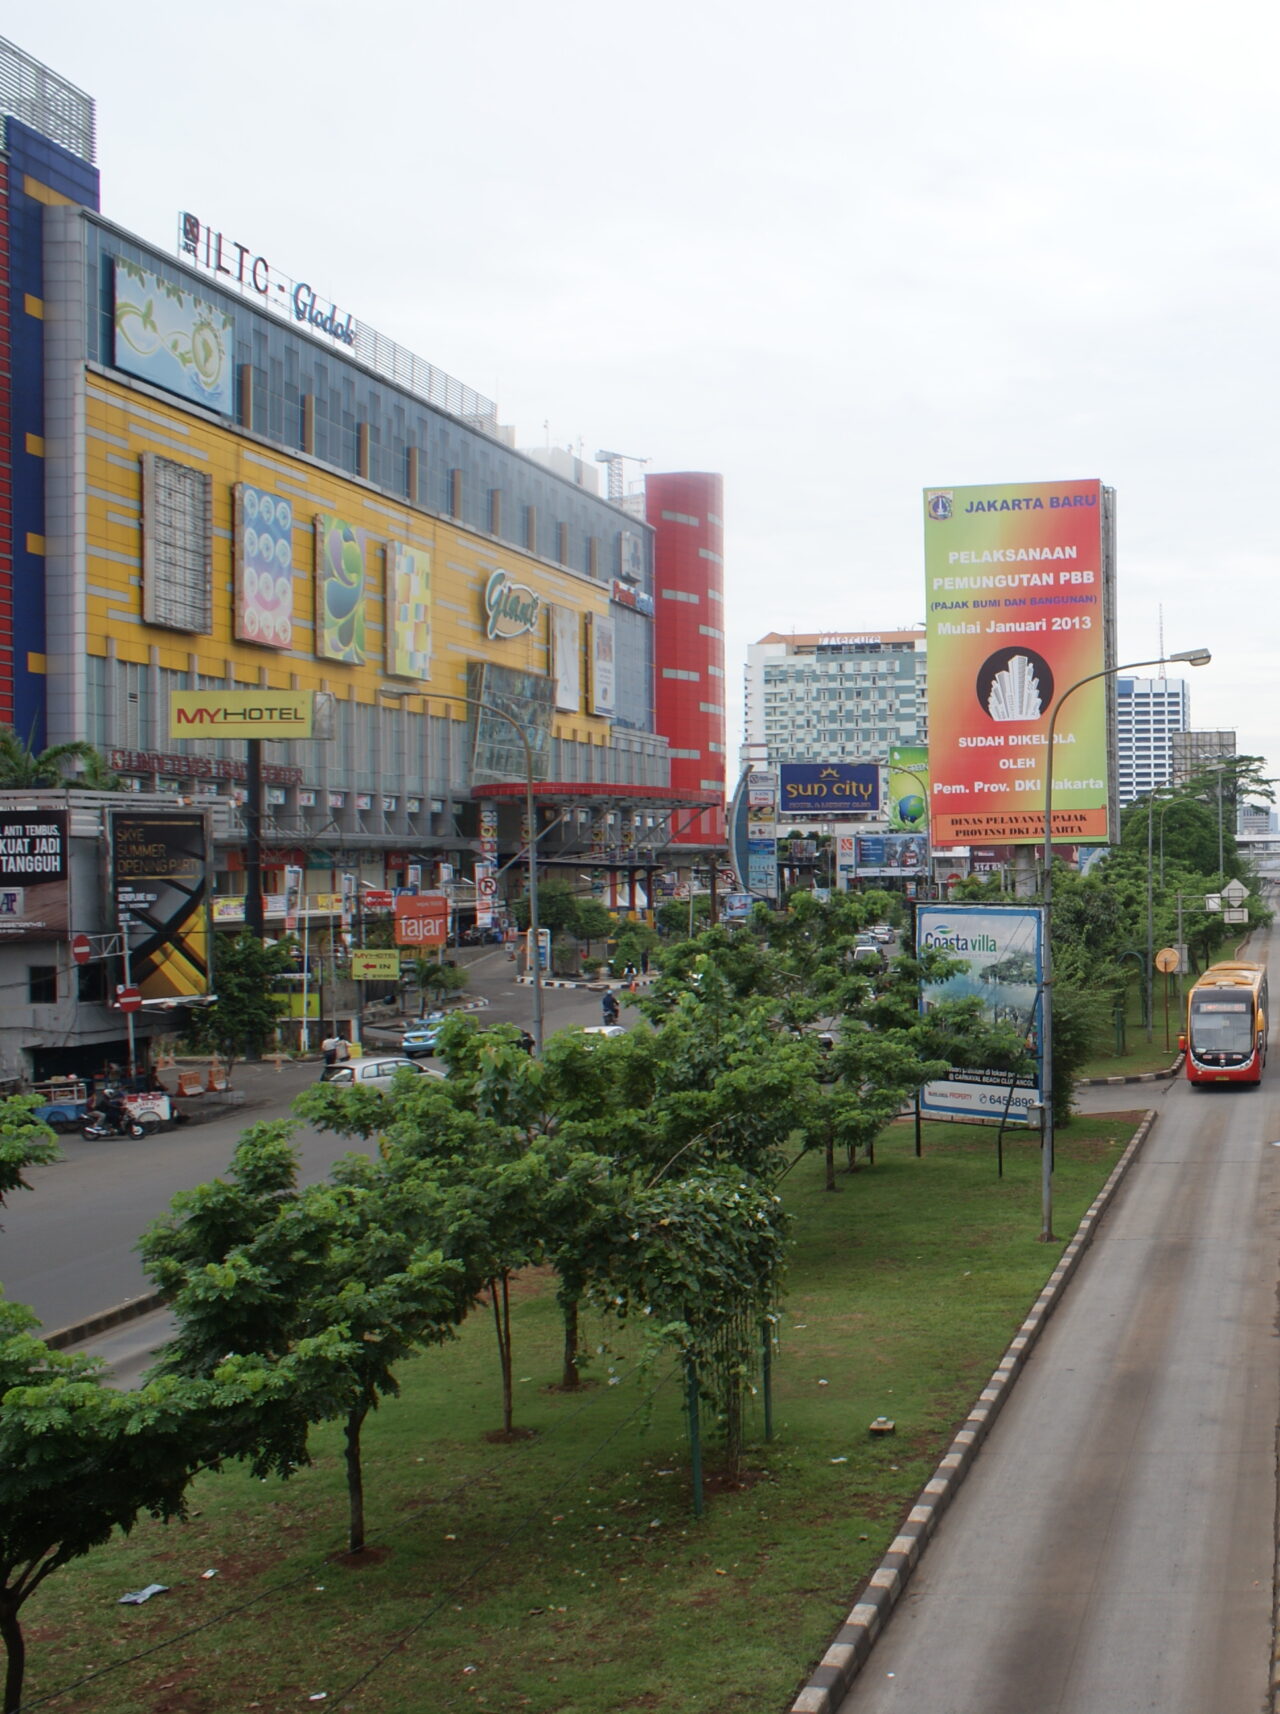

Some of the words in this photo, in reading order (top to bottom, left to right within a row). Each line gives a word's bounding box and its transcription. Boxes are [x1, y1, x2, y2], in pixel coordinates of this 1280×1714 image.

[293, 283, 355, 345] Glodok
[964, 498, 1044, 513] JAKARTA
[1049, 494, 1097, 509] BARU
[948, 546, 1078, 564] PELAKSANAAN
[933, 574, 1055, 590] PEMUNGUTAN
[1059, 571, 1095, 586] PBB
[486, 569, 539, 639] Giant
[930, 599, 969, 612] (PAJAK
[972, 599, 1001, 609] BUMI
[1004, 597, 1027, 607] DAN
[1030, 594, 1098, 606] BANGUNAN)
[937, 620, 981, 635] Mulai
[985, 618, 1047, 633] Januari
[1051, 616, 1092, 631] 2013
[958, 735, 1004, 748] SUDAH
[999, 757, 1036, 770] OLEH
[786, 783, 828, 799] sun
[832, 780, 873, 800] city
[933, 782, 970, 795] Pem.
[974, 780, 1010, 793] Prov.
[1014, 779, 1041, 791] DKI
[951, 816, 981, 827] DINAS
[1052, 813, 1088, 824] PAJAK
[4, 825, 23, 836] ANTI
[116, 829, 145, 842] SKYE
[955, 827, 1006, 837] PROVINSI
[1010, 826, 1029, 836] DKI
[0, 838, 30, 854] KUAT
[34, 837, 60, 854] JADI
[116, 844, 166, 857] SUMMER
[0, 856, 60, 873] TANGGUH
[117, 859, 168, 873] OPENING
[399, 914, 444, 941] fajar
[925, 931, 968, 951] Coasta
[970, 934, 997, 953] villa
[955, 1074, 982, 1082] CARNAVAL
